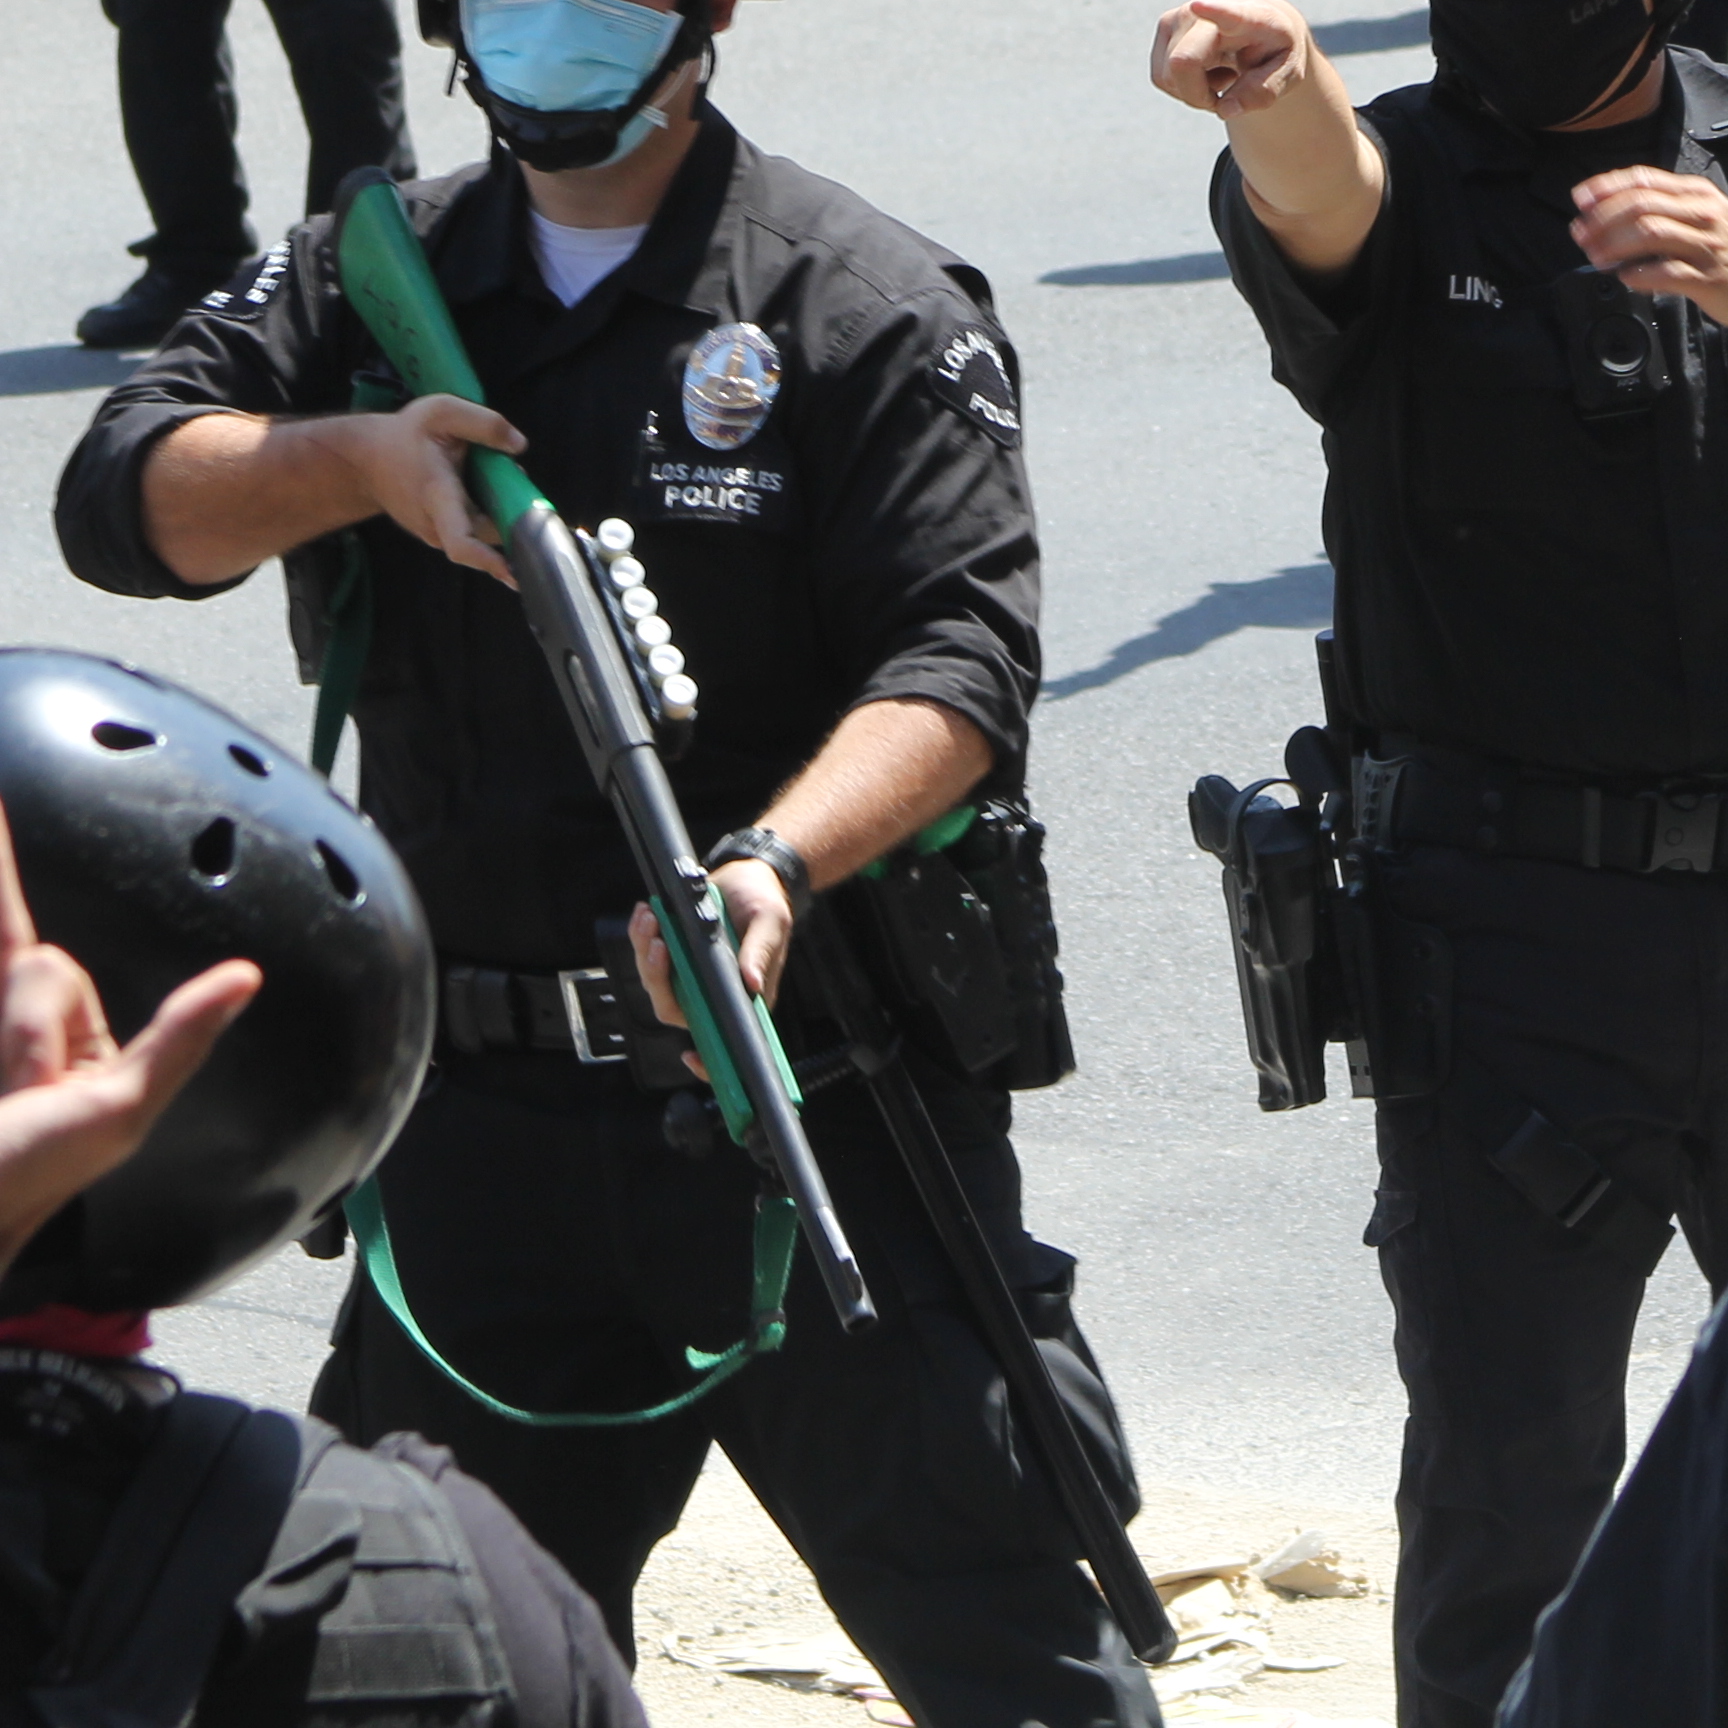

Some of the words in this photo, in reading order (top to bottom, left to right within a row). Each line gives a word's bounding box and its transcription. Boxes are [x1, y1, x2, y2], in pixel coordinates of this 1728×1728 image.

[650, 462, 691, 482] LOS
[691, 464, 785, 493] ANGELES
[664, 484, 763, 516] POLICE
